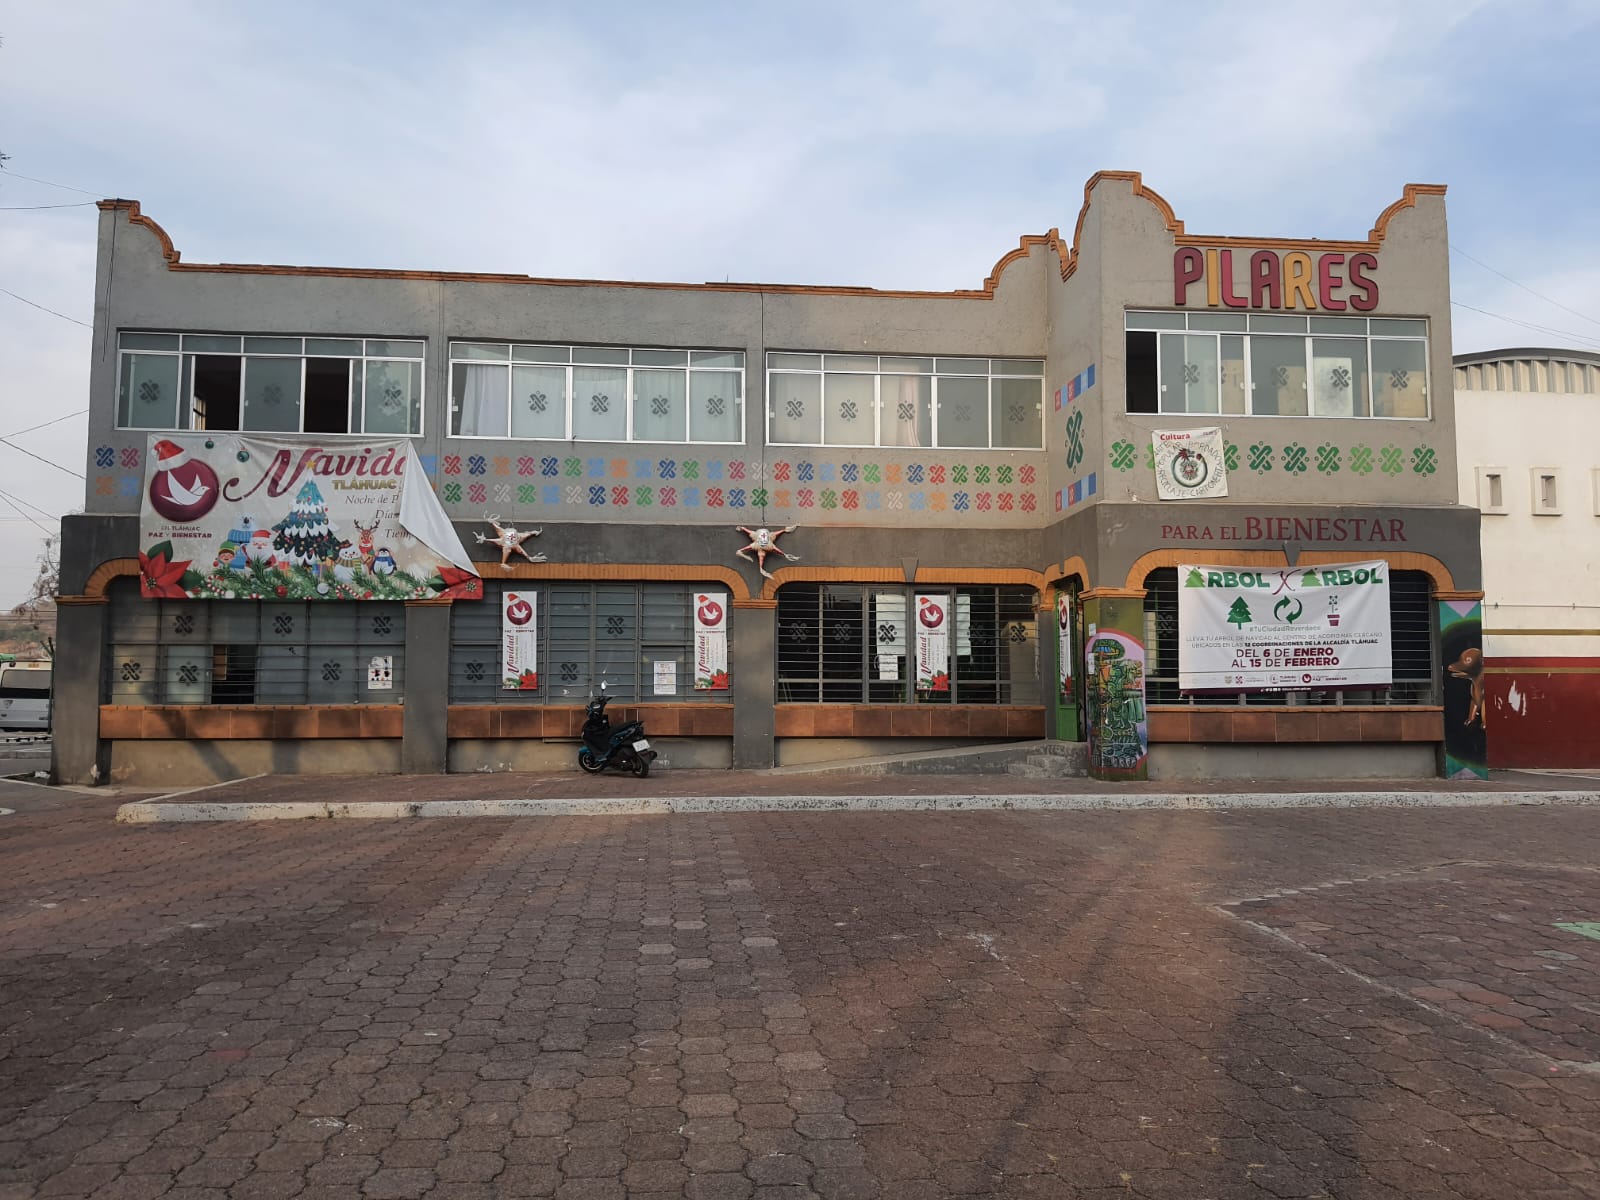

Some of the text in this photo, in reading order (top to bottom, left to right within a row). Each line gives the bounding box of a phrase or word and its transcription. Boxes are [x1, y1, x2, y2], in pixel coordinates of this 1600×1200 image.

[1174, 247, 1378, 311] PILARES
[1160, 433, 1191, 441] Cultura
[345, 494, 375, 504] Noche
[378, 494, 389, 504] de
[1161, 516, 1408, 542] PARA EL BIENESTAR
[698, 635, 711, 676] Navidad
[920, 636, 932, 677] Navidad
[1236, 647, 1334, 658] DEL 6 DE ENERO
[1231, 657, 1340, 668] AL 15 DE FEBRERO
